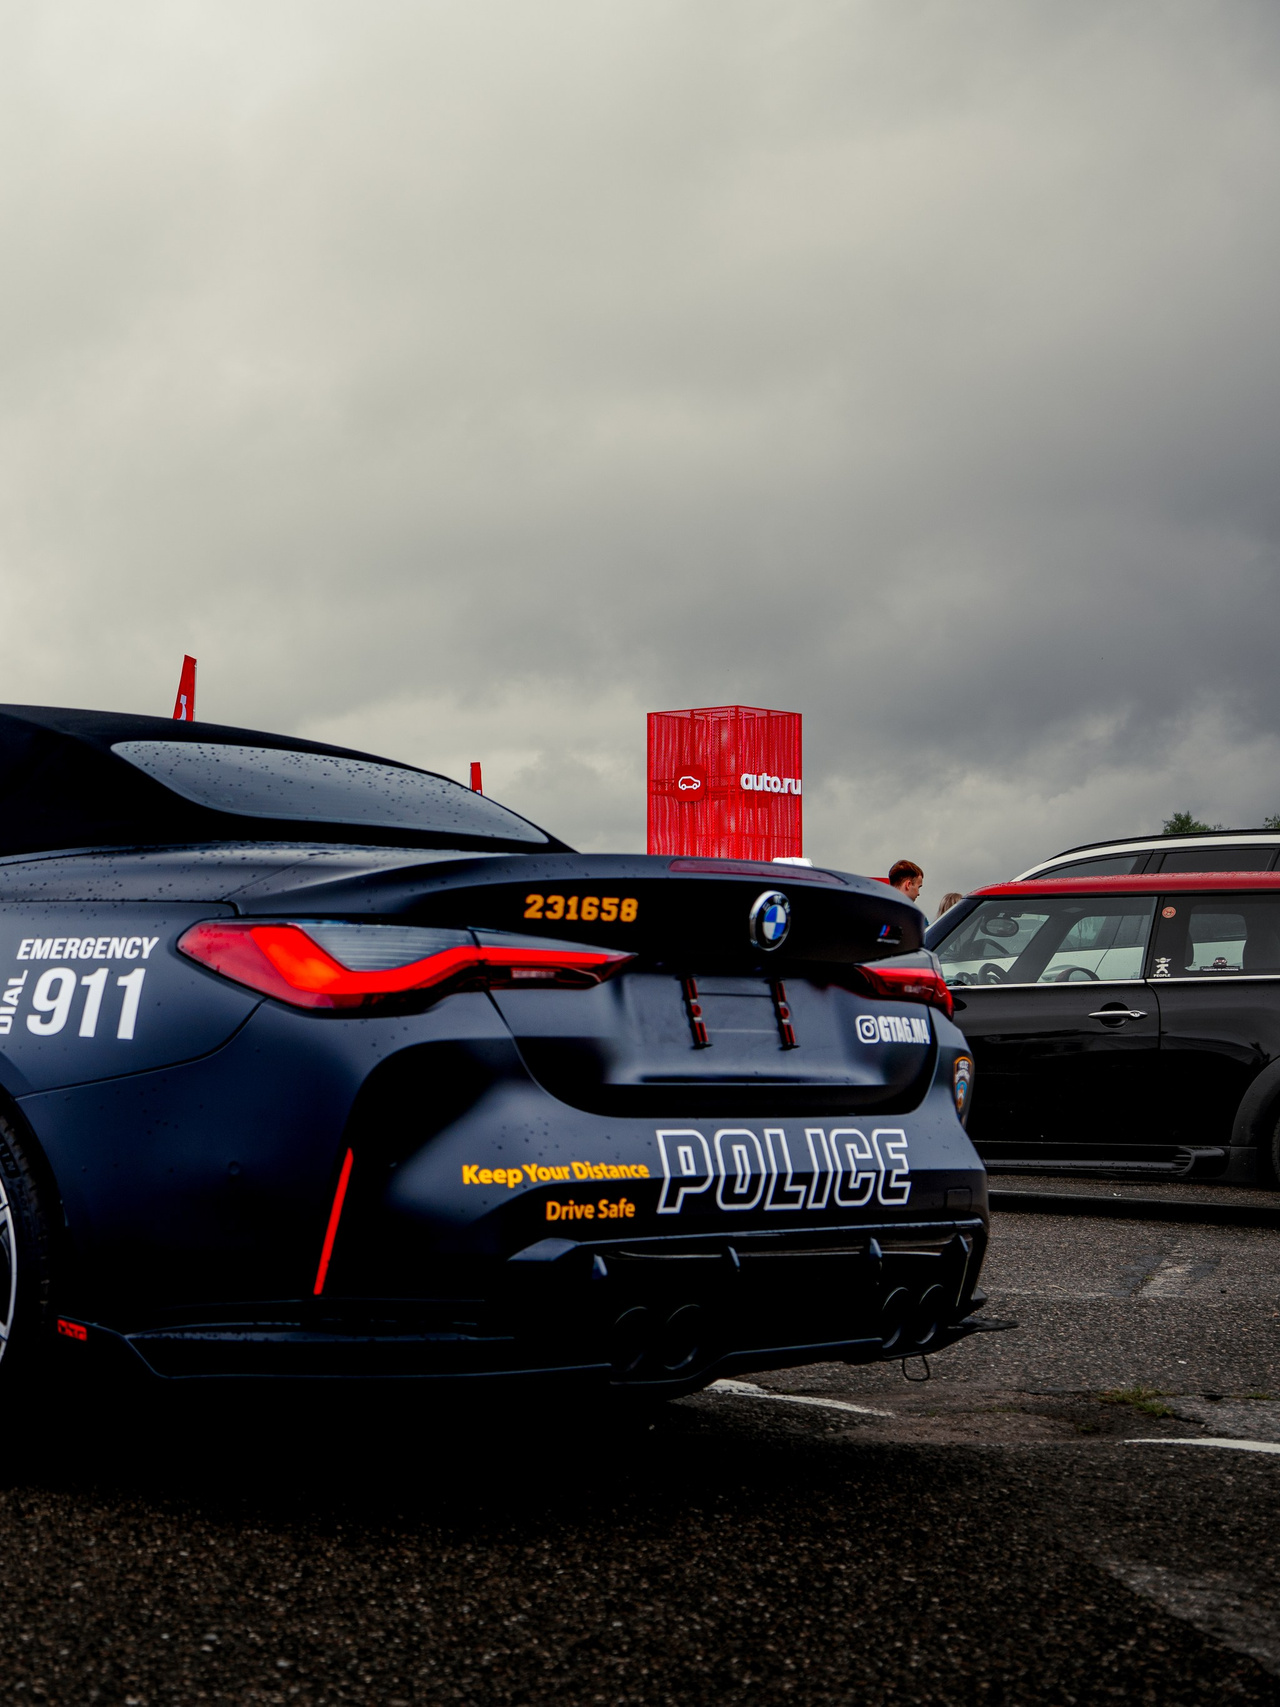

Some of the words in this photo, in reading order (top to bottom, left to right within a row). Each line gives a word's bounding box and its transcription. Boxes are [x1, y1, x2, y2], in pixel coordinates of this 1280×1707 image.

[740, 772, 802, 795] auto.ru
[523, 894, 639, 923] 231658
[16, 936, 160, 960] EMERGENCY
[26, 967, 146, 1040] 911
[877, 1016, 931, 1044] GTA6.M4
[462, 1164, 523, 1188] Keep
[522, 1163, 570, 1183] Your
[571, 1161, 650, 1180] Distance
[657, 1128, 911, 1215] POLICE
[545, 1199, 595, 1221] Drive
[597, 1197, 636, 1219] Safe
